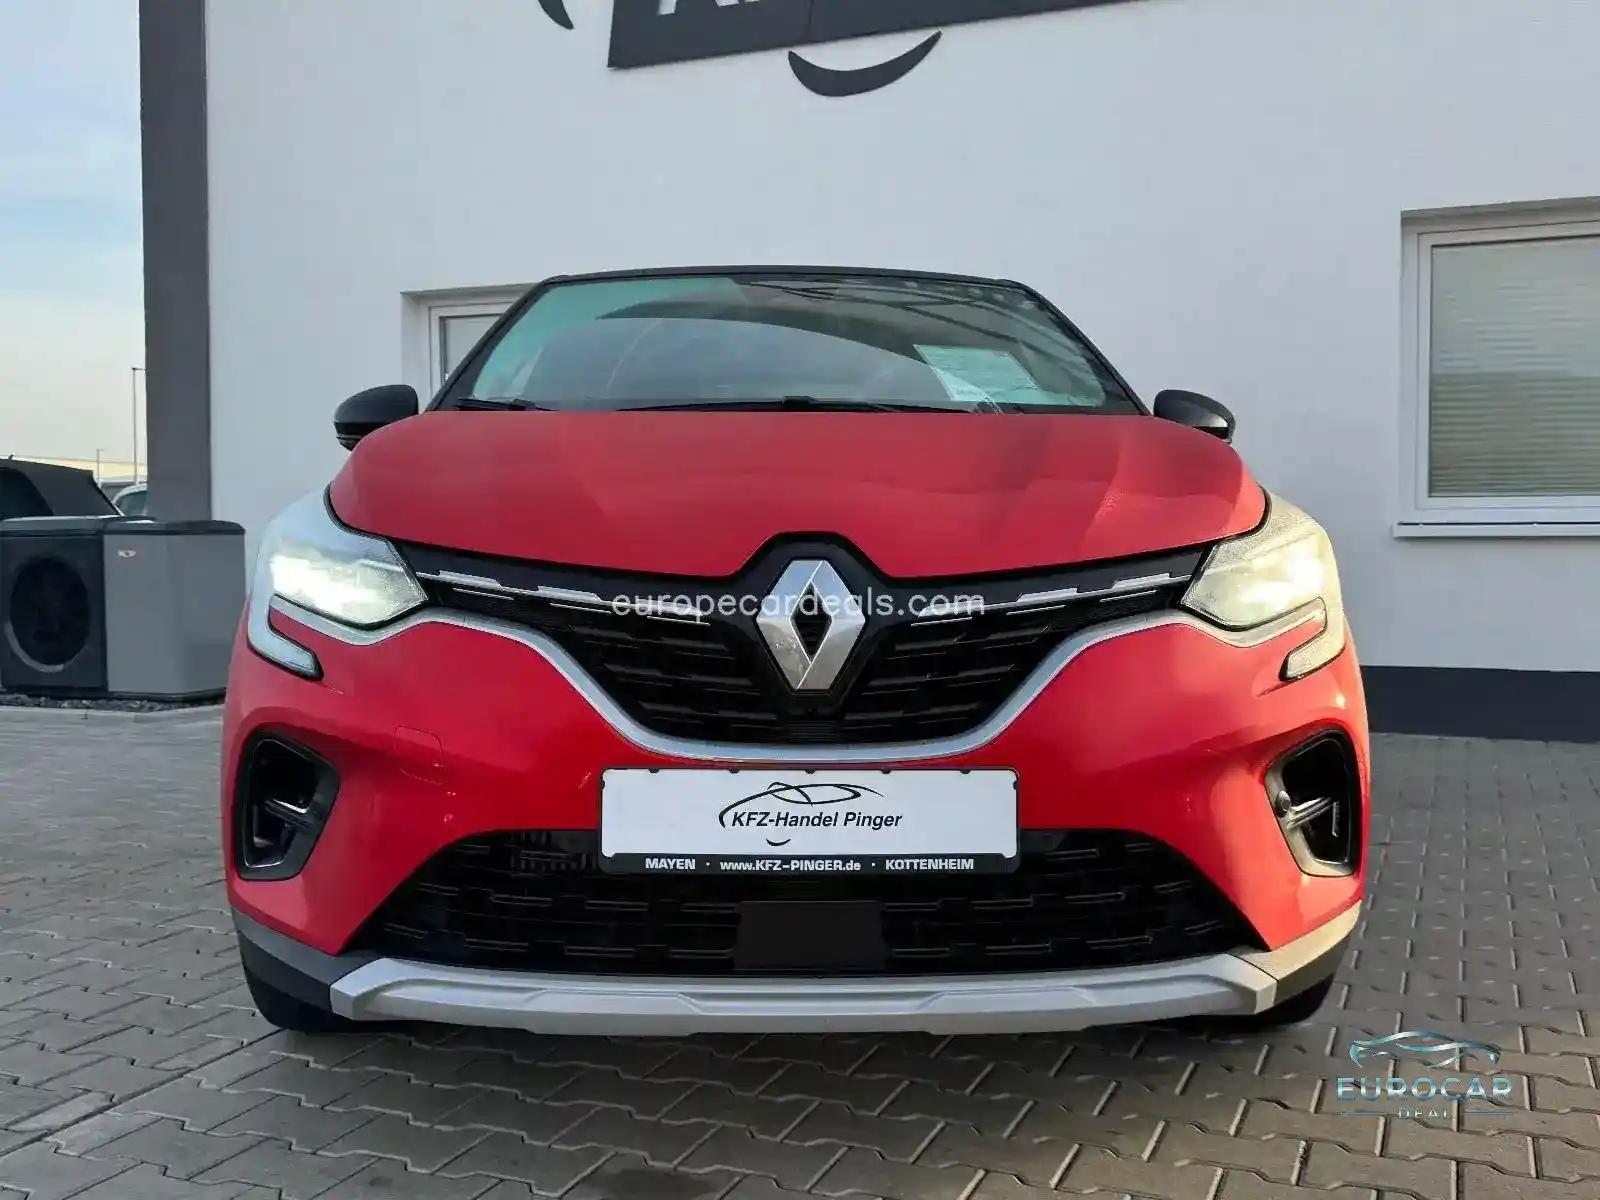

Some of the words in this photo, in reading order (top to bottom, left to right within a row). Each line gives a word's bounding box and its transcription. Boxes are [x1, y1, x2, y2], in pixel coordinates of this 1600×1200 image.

[732, 811, 839, 827] KFZ-Handel
[843, 811, 903, 831] Pinger
[645, 857, 696, 870] MAYEN
[719, 859, 862, 871] www.KFZ-PINGER.de
[885, 858, 974, 871] KOTTENHEIM
